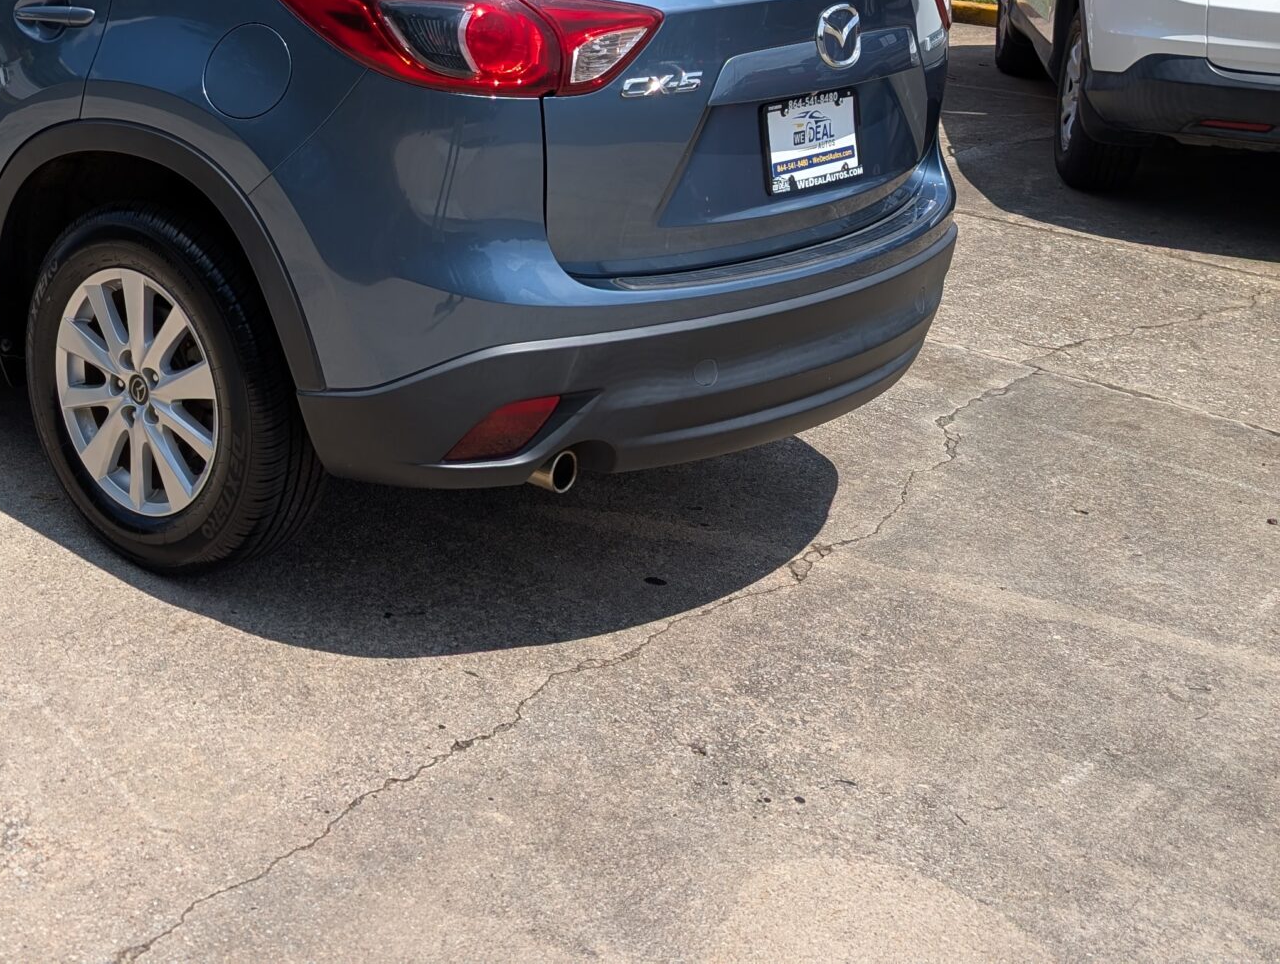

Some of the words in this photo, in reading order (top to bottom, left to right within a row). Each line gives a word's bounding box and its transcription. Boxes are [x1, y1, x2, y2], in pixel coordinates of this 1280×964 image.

[621, 70, 703, 98] CX-5
[788, 92, 838, 110] 864-541-8480
[794, 132, 805, 145] WE
[808, 122, 835, 142] DEAL
[817, 139, 836, 150] AUTOS
[776, 159, 809, 173] 864-541-8480
[812, 149, 853, 164] WeDealAutos.com
